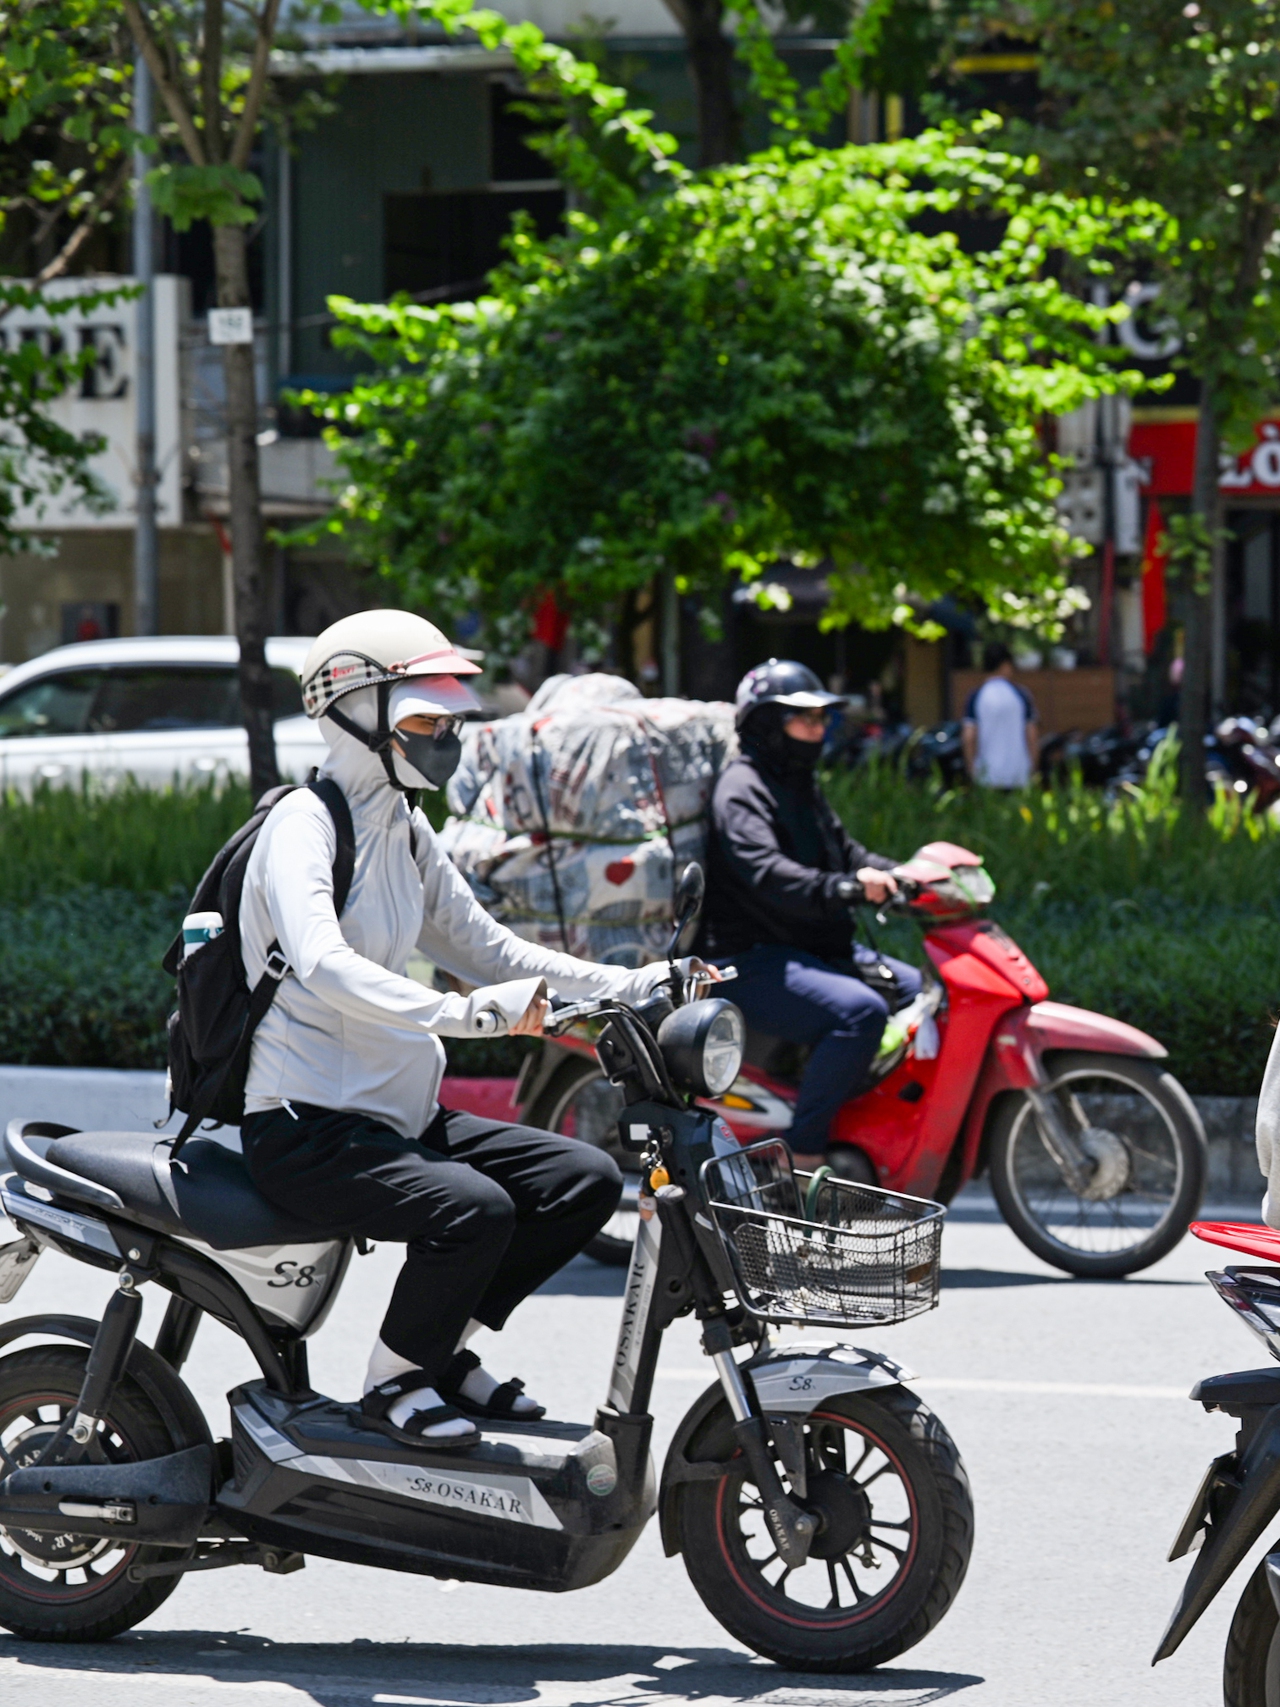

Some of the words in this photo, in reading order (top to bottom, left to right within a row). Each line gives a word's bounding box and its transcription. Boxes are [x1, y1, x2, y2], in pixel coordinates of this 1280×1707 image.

[267, 1260, 316, 1288] S8
[616, 1261, 645, 1367] OSAKAR
[789, 1375, 813, 1392] S8
[410, 1477, 433, 1494] S8
[437, 1482, 522, 1514] OSAKAR
[769, 1508, 791, 1552] OSAKAR
